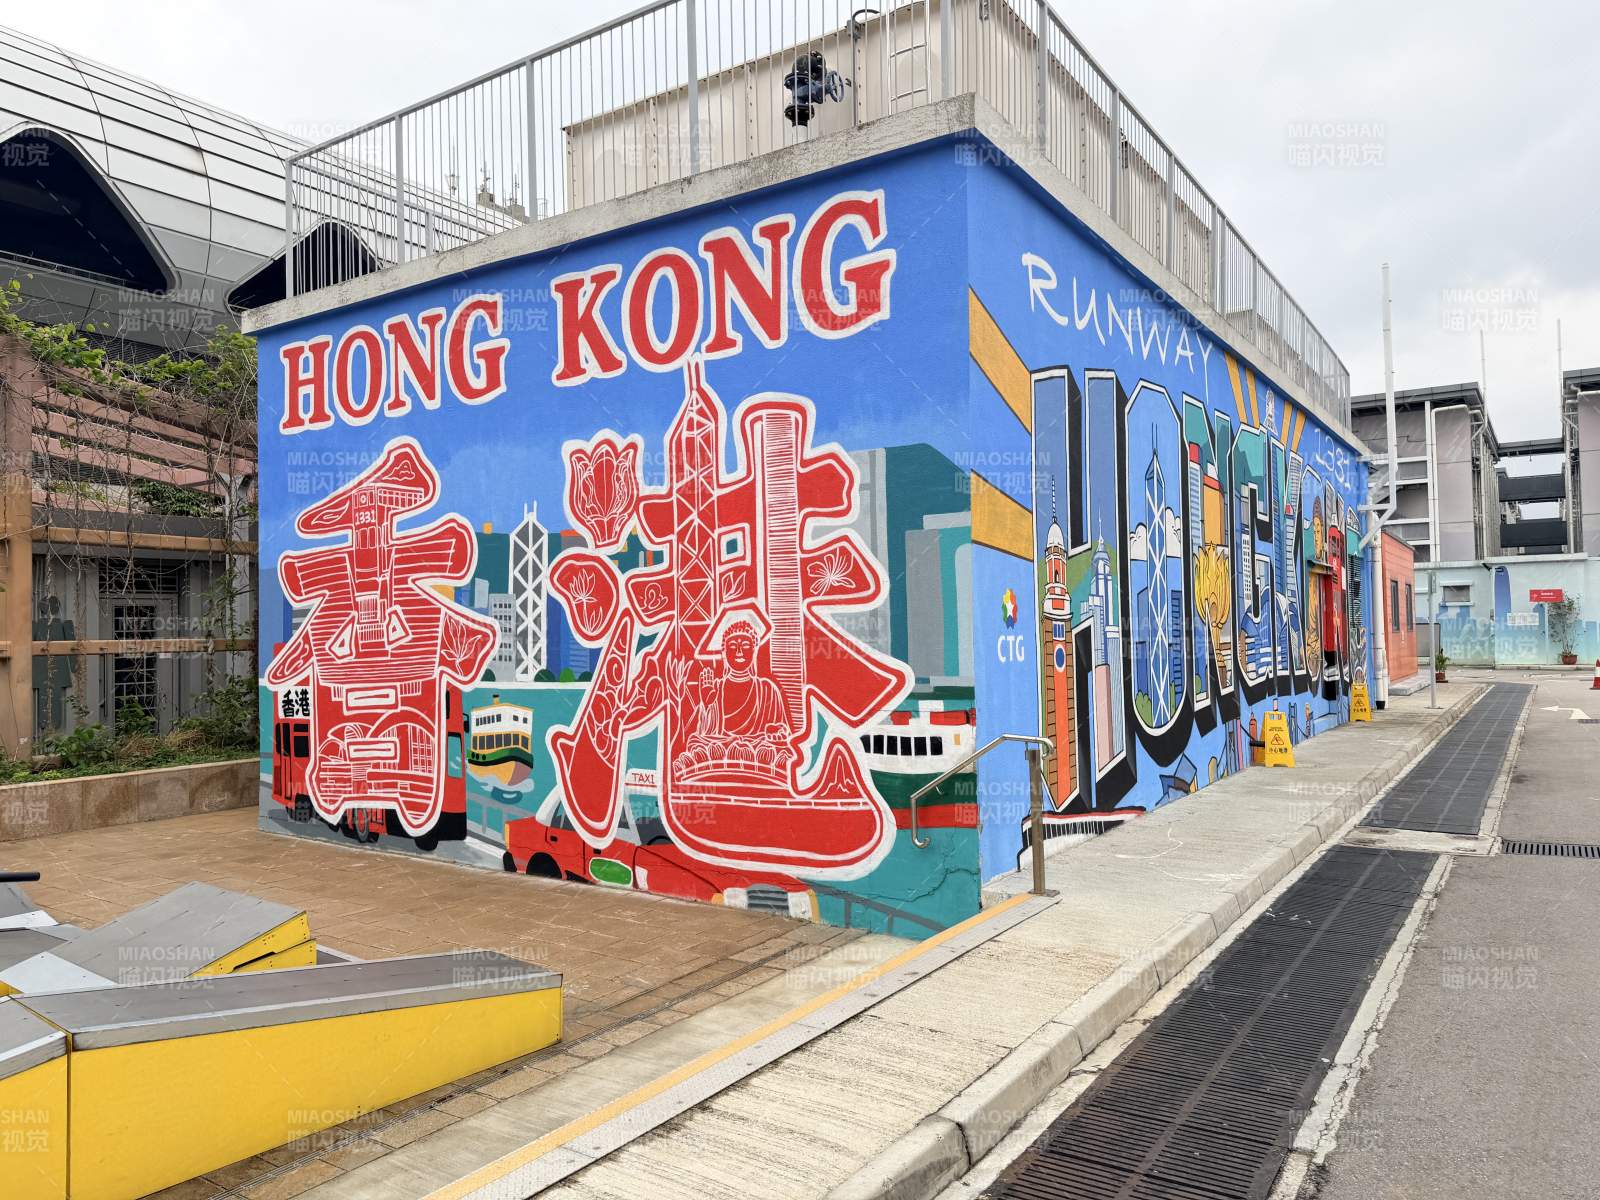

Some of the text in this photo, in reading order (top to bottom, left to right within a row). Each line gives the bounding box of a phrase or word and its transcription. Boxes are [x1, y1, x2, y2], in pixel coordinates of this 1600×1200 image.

[279, 188, 898, 435] HONG KONG
[1021, 251, 1213, 404] RUNWAY
[1314, 428, 1352, 490] 1331
[355, 510, 376, 525] 1331
[258, 375, 915, 882] 香港
[997, 634, 1025, 663] CTG
[281, 688, 310, 717] 香港
[631, 772, 655, 784] TAXI
